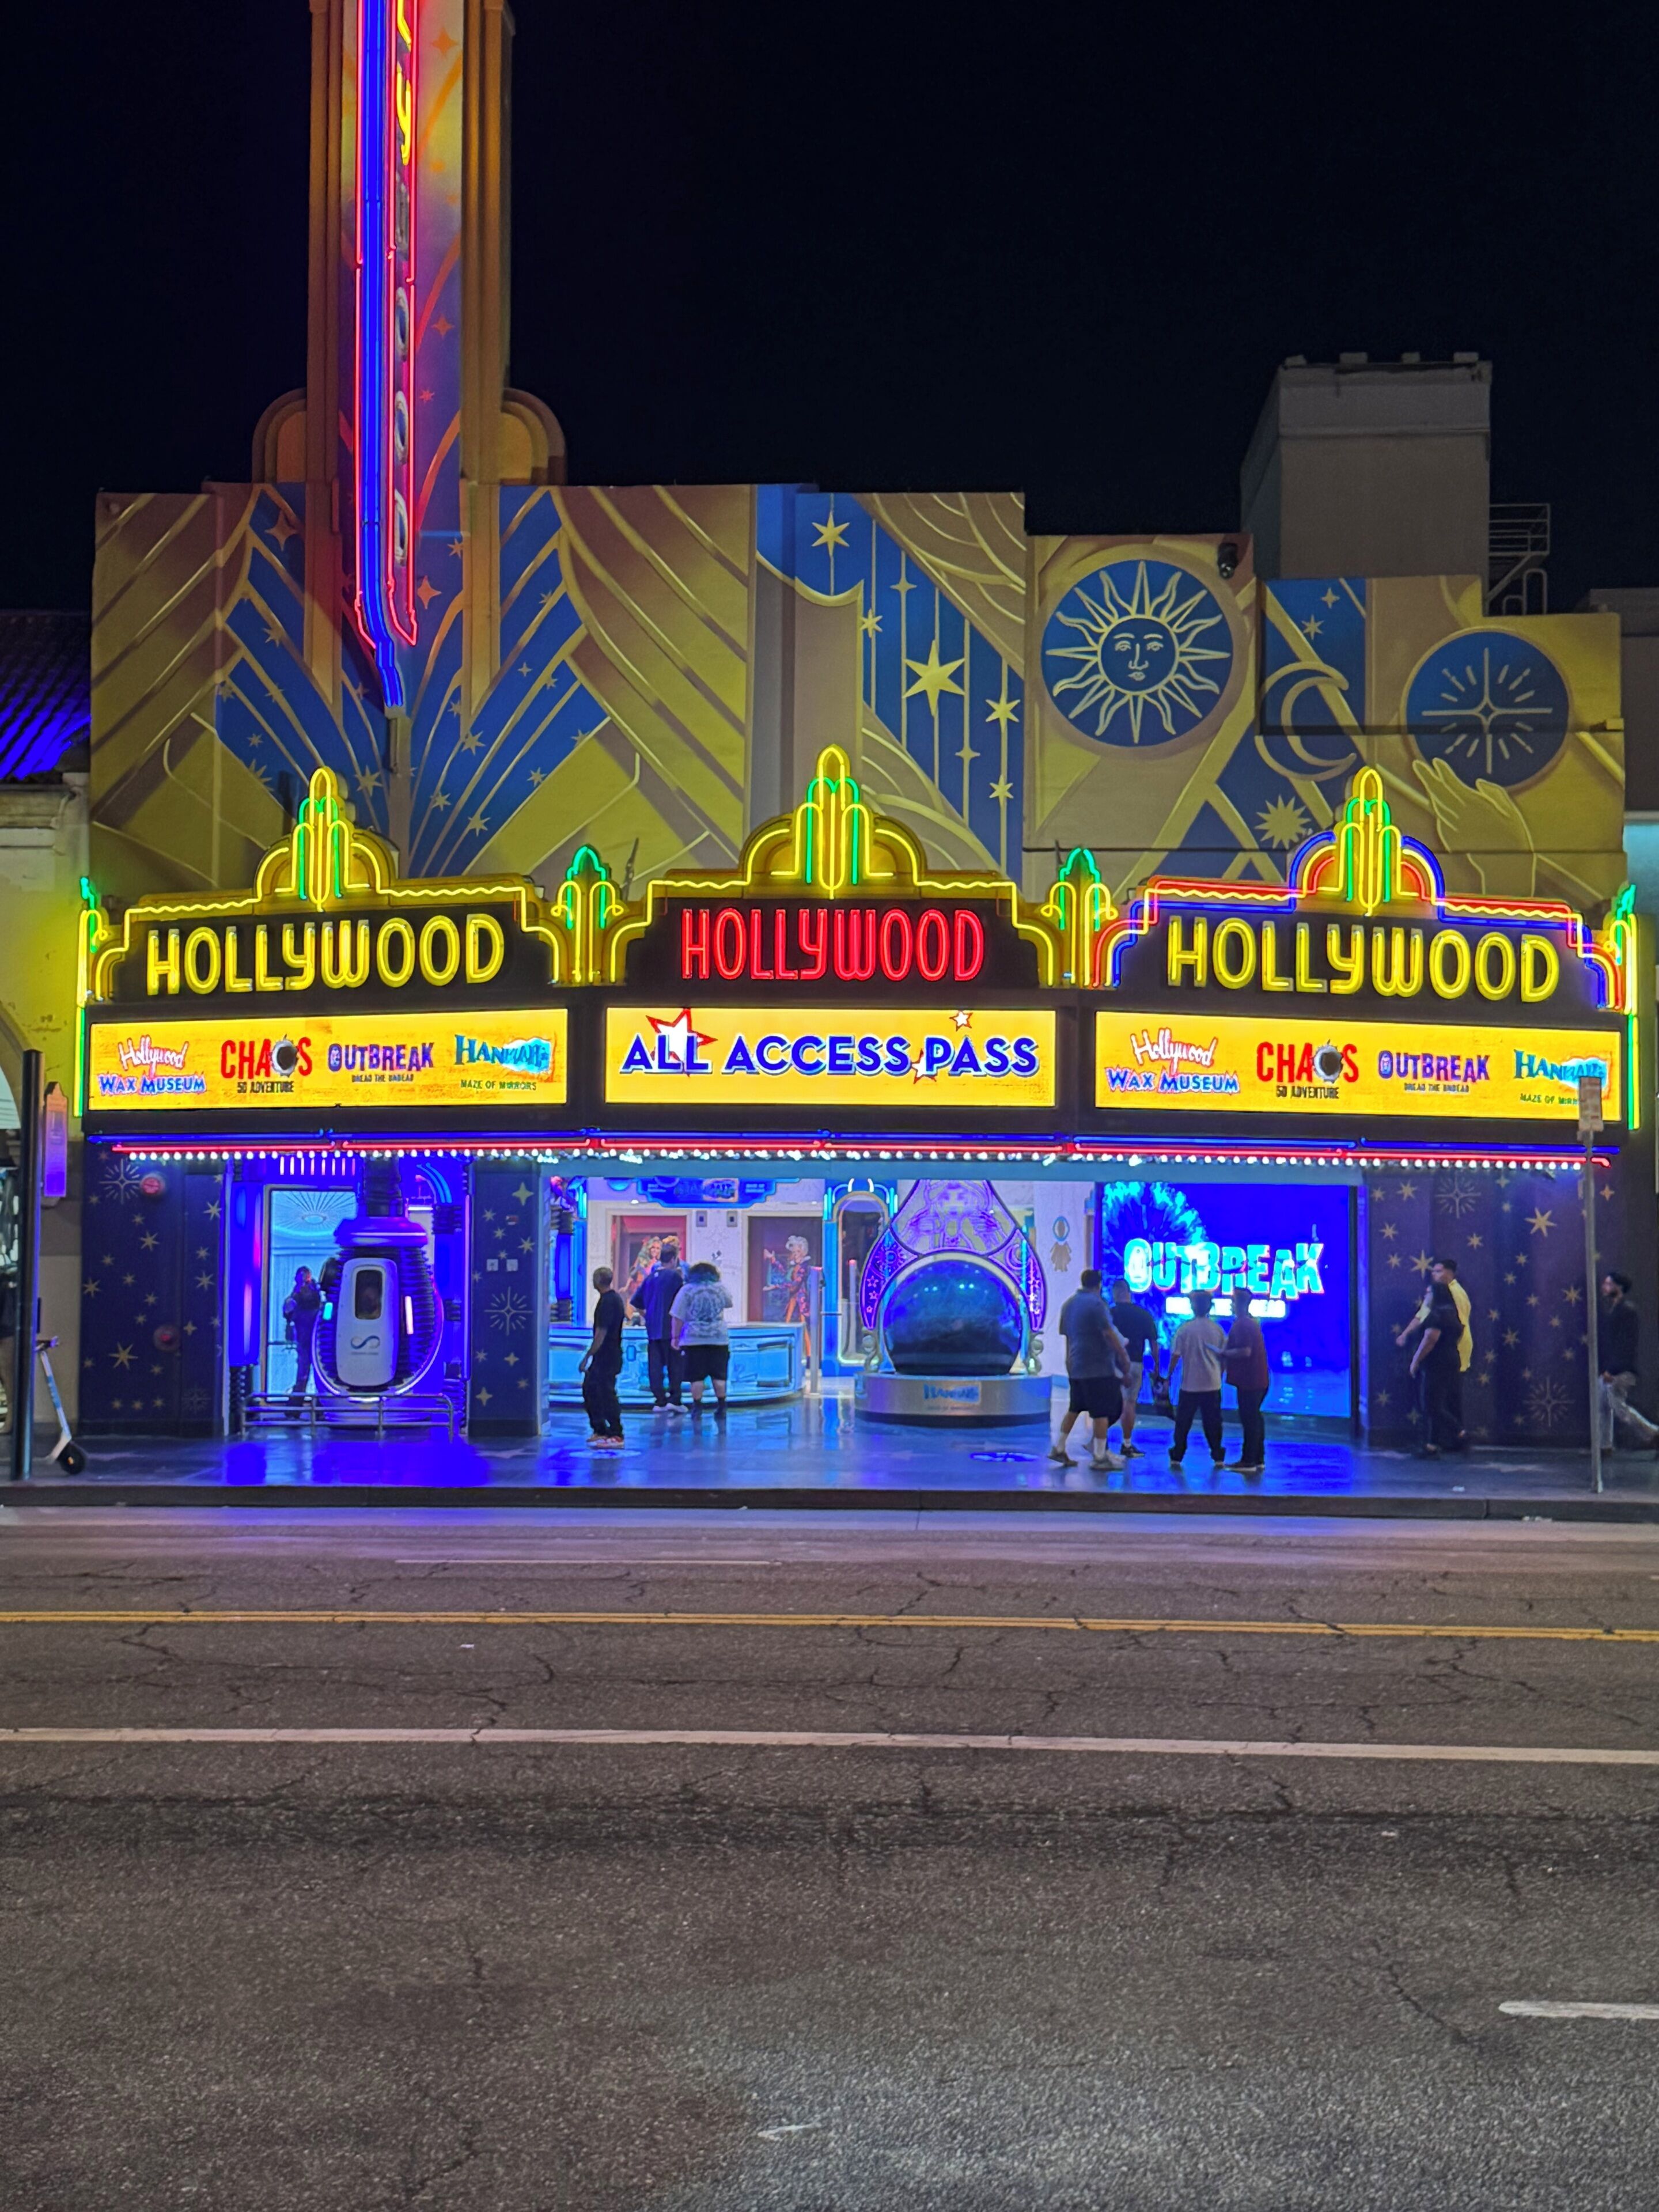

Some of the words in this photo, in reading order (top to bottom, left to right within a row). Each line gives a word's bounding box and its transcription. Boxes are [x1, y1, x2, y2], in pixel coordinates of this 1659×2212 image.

[146, 912, 505, 996] HOLLYWOOD
[680, 908, 985, 982] HOLLYWOOD
[1166, 915, 1560, 1003] HOLLYWOOD
[118, 1035, 189, 1078] Hollywood
[221, 1035, 313, 1079] CHAOS
[328, 1042, 434, 1072] OUTBREAK
[620, 1033, 713, 1075] ALL
[721, 1035, 912, 1075] ACCESS
[922, 1036, 1039, 1077] PASS
[1130, 1028, 1218, 1076] Hollywood
[1256, 1039, 1359, 1084] CHAOS
[1378, 1050, 1490, 1082] OUTBREAK
[249, 1081, 294, 1093] ADVENTURE
[460, 1079, 483, 1089] MAZE
[485, 1080, 496, 1089] OF
[1290, 1086, 1339, 1099] ADVENTURE
[1520, 1093, 1541, 1103] MAZE
[1124, 1238, 1324, 1300] OUTBREAK
